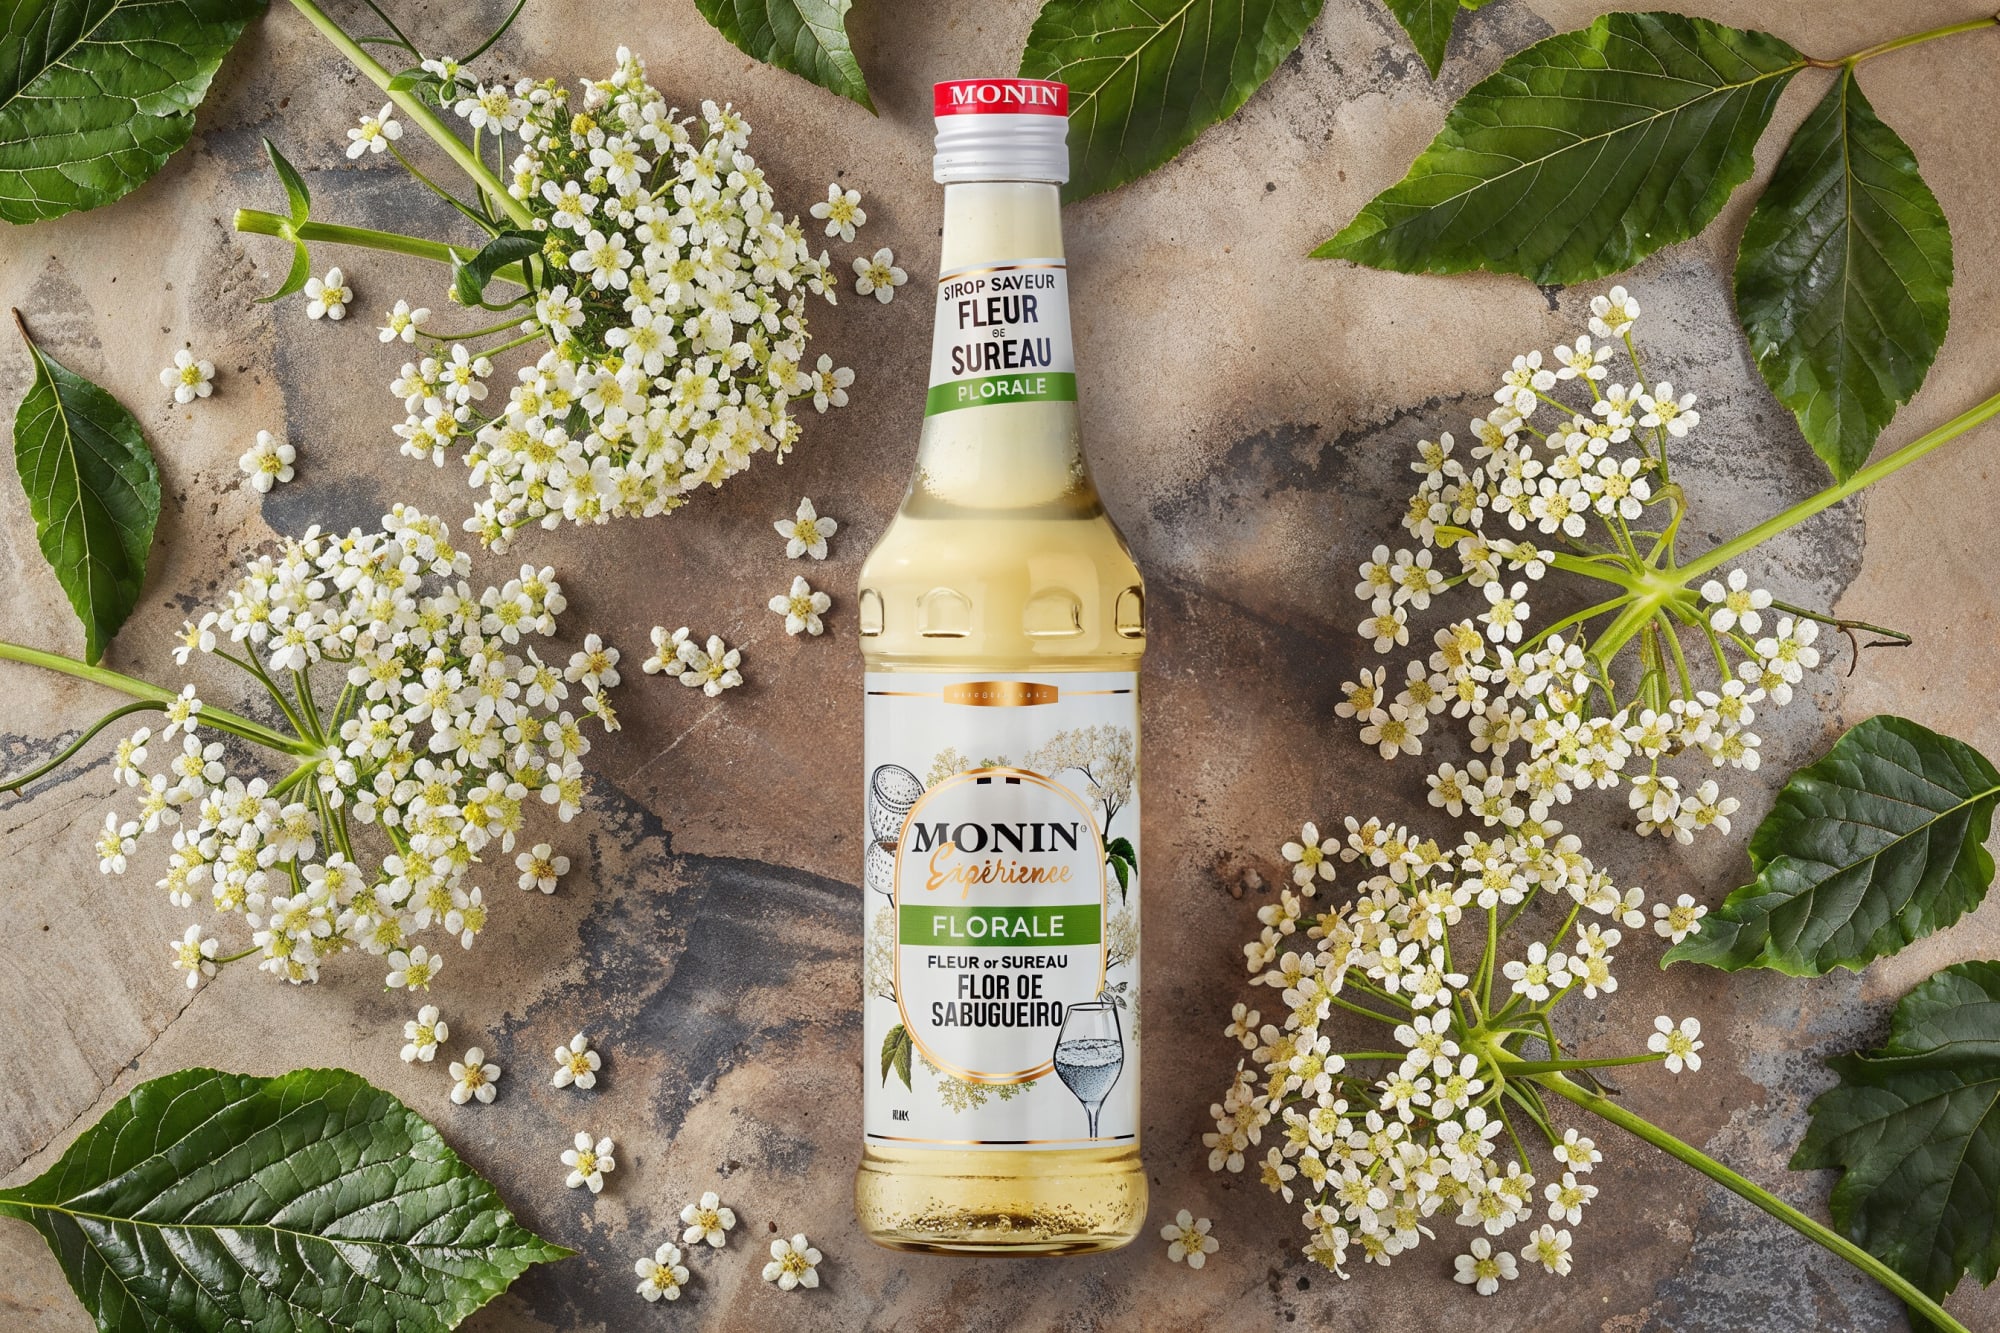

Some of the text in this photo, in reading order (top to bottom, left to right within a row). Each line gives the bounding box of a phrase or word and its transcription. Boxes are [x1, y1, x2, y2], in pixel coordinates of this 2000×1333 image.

[950, 84, 1061, 107] MONIN
[944, 274, 1055, 301] SIROP SAVEUR
[958, 294, 1039, 330] FLEUR
[952, 337, 1051, 376] SUREAU
[912, 822, 1079, 853] MONIN
[932, 915, 1065, 938] FLORALE
[928, 955, 979, 969] FLEUR
[1001, 954, 1068, 969] SUREAU
[958, 974, 1010, 1000] FLOR
[932, 1001, 1063, 1028] SABUGUEIRO
